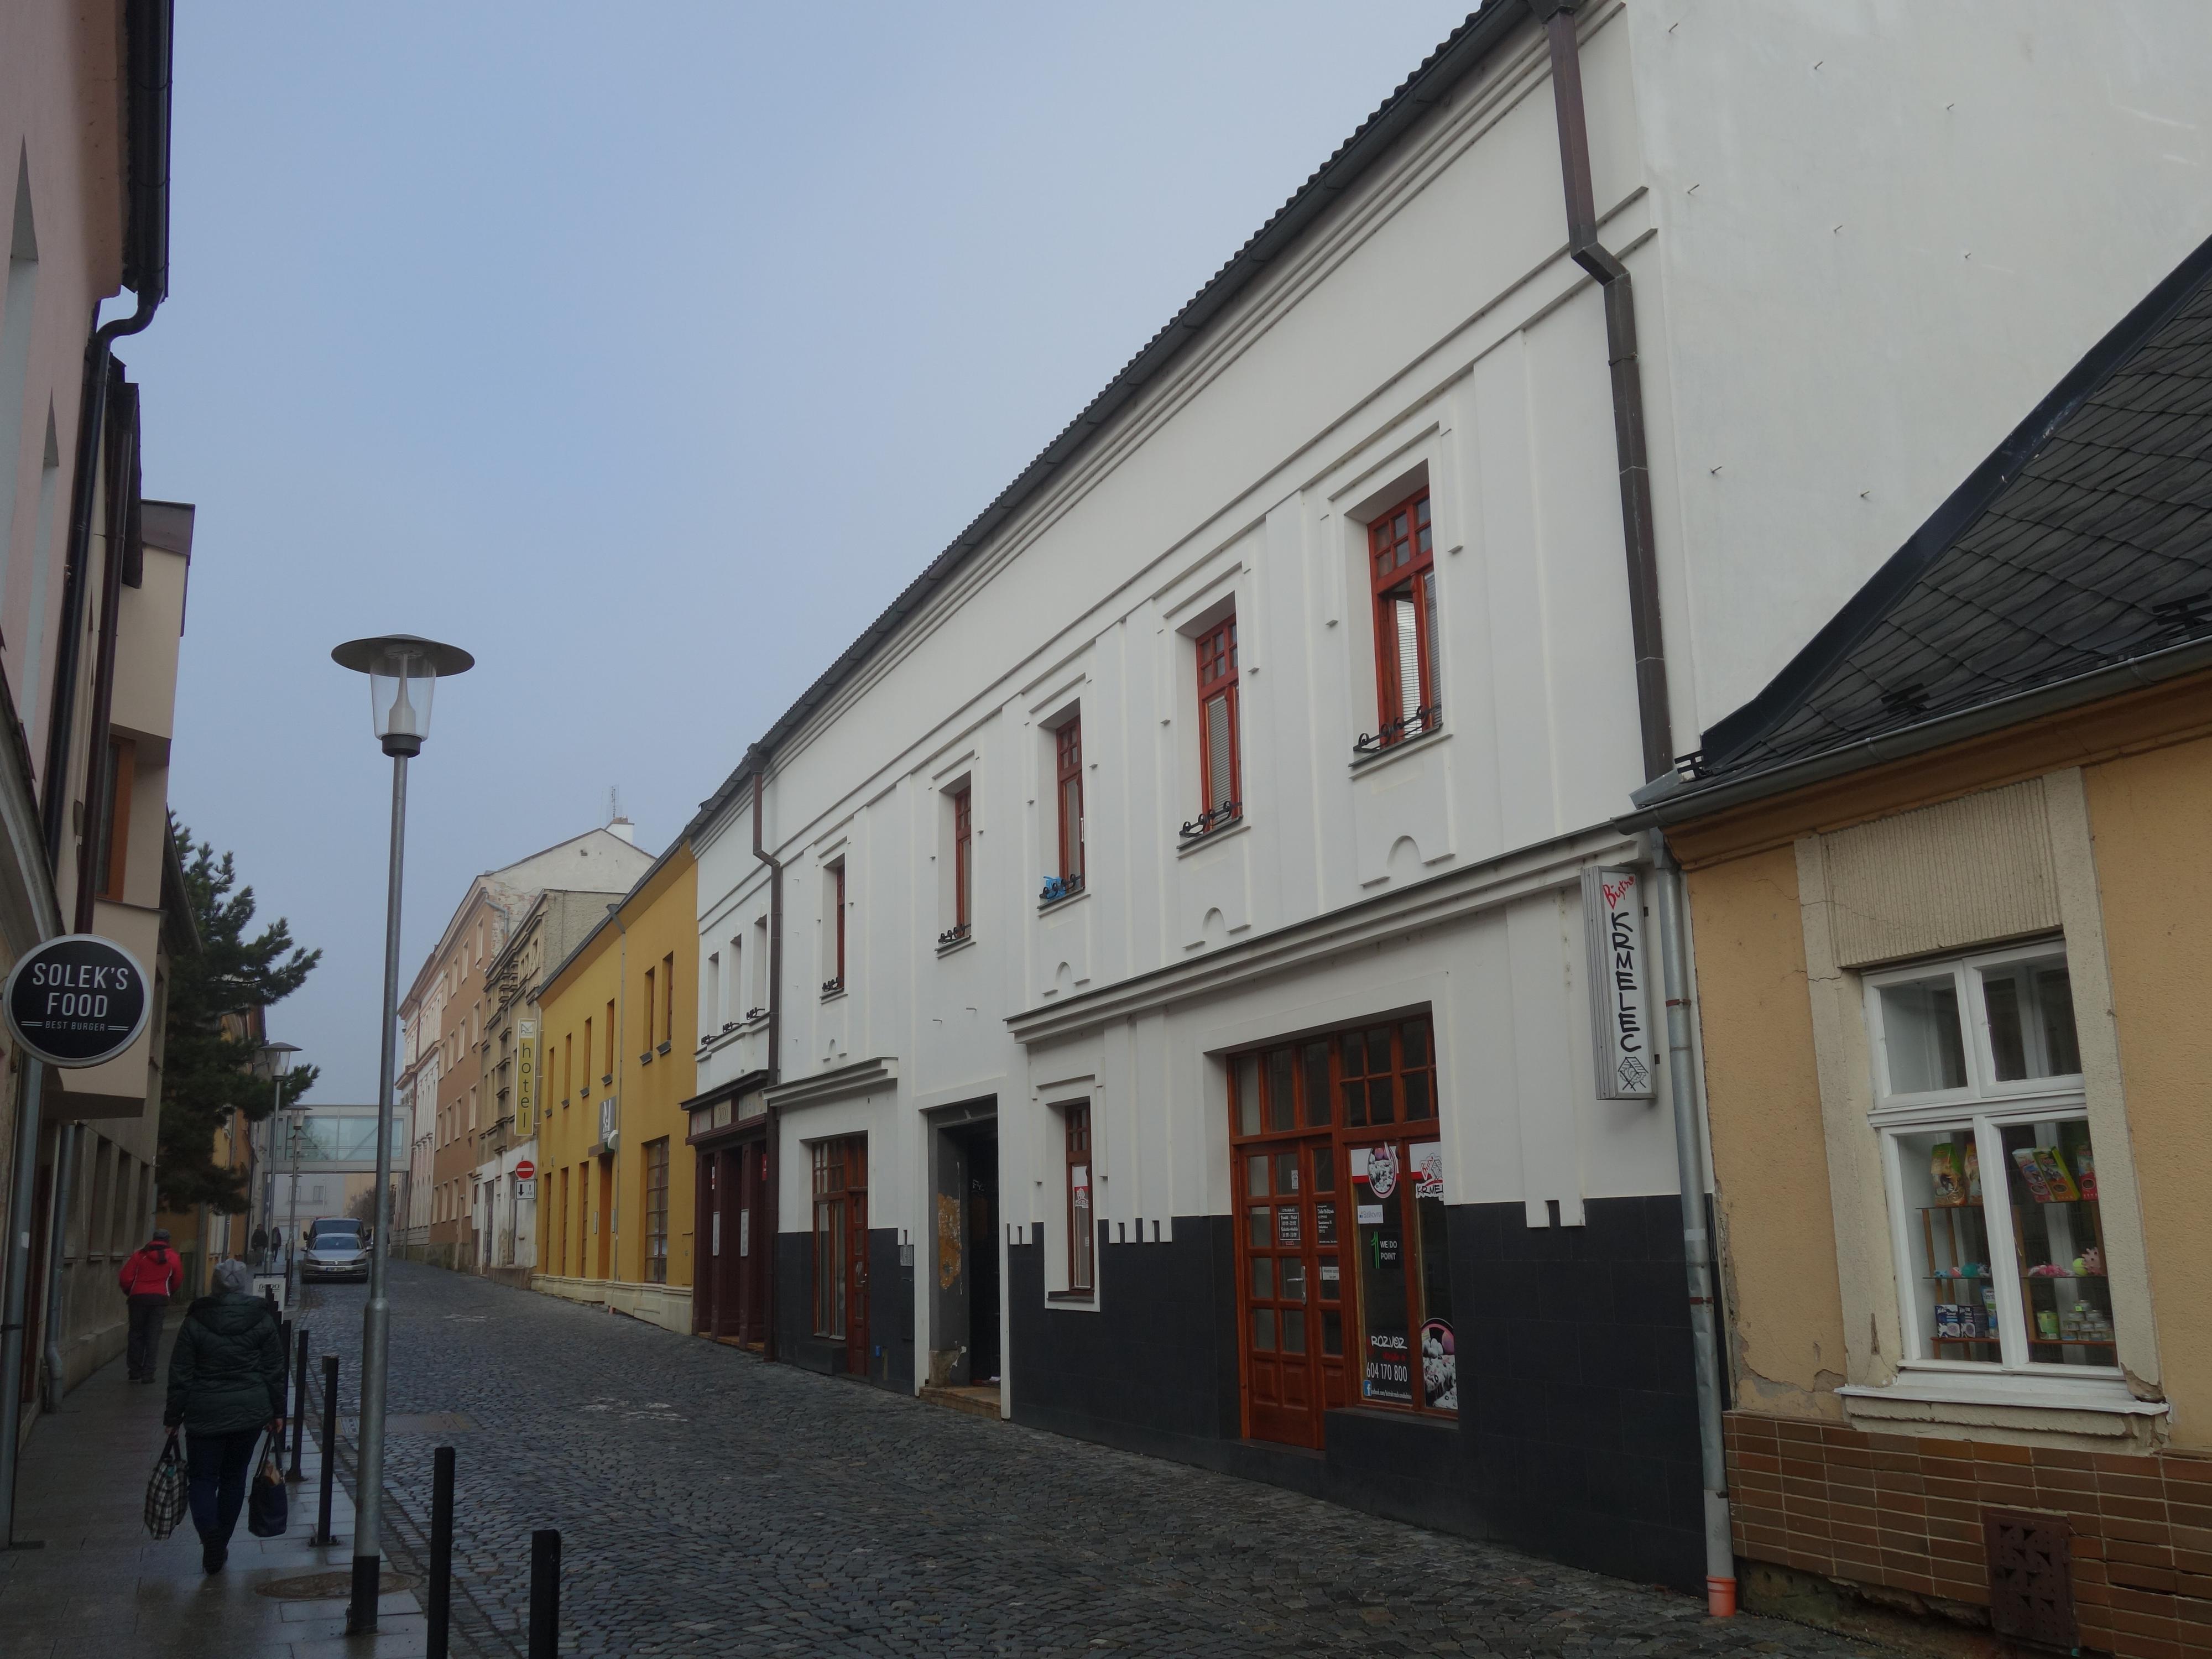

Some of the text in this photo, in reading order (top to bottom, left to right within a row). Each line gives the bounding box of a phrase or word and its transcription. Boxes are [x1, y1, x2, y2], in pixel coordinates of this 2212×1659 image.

[1603, 875, 1635, 910] Bistro
[32, 963, 128, 990] SOLEK'S
[1611, 911, 1641, 1052] KRMELEC
[46, 992, 108, 1018] FOOD
[45, 1021, 105, 1031] BEST BURGER
[521, 1042, 531, 1128] hotel
[1417, 1185, 1443, 1194] KRME
[1371, 1335, 1408, 1349] ROZVOZ
[1366, 1362, 1407, 1382] 604 170 800
